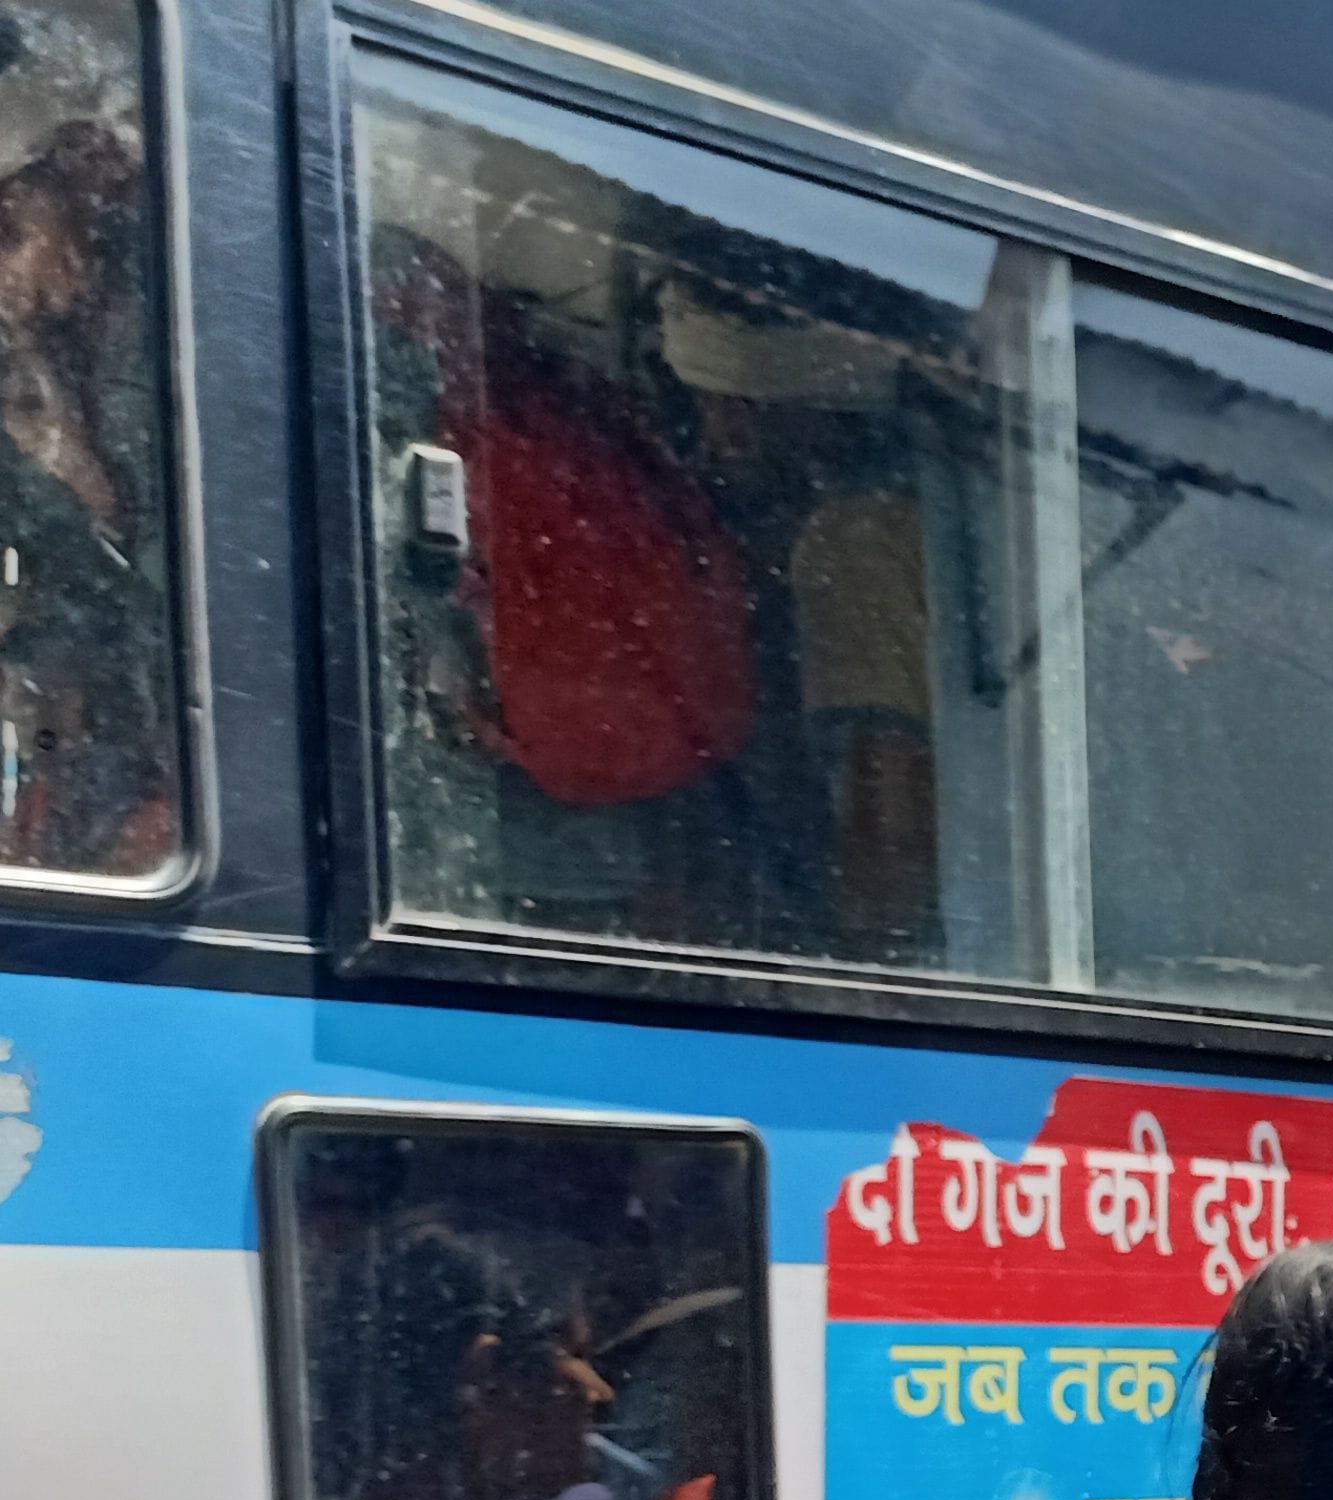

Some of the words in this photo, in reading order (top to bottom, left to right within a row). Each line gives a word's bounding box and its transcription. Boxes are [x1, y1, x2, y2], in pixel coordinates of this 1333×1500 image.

[938, 1139, 1068, 1251] गज
[1084, 1110, 1175, 1256] की
[890, 1343, 1027, 1425] जब
[1048, 1346, 1178, 1425] तक
